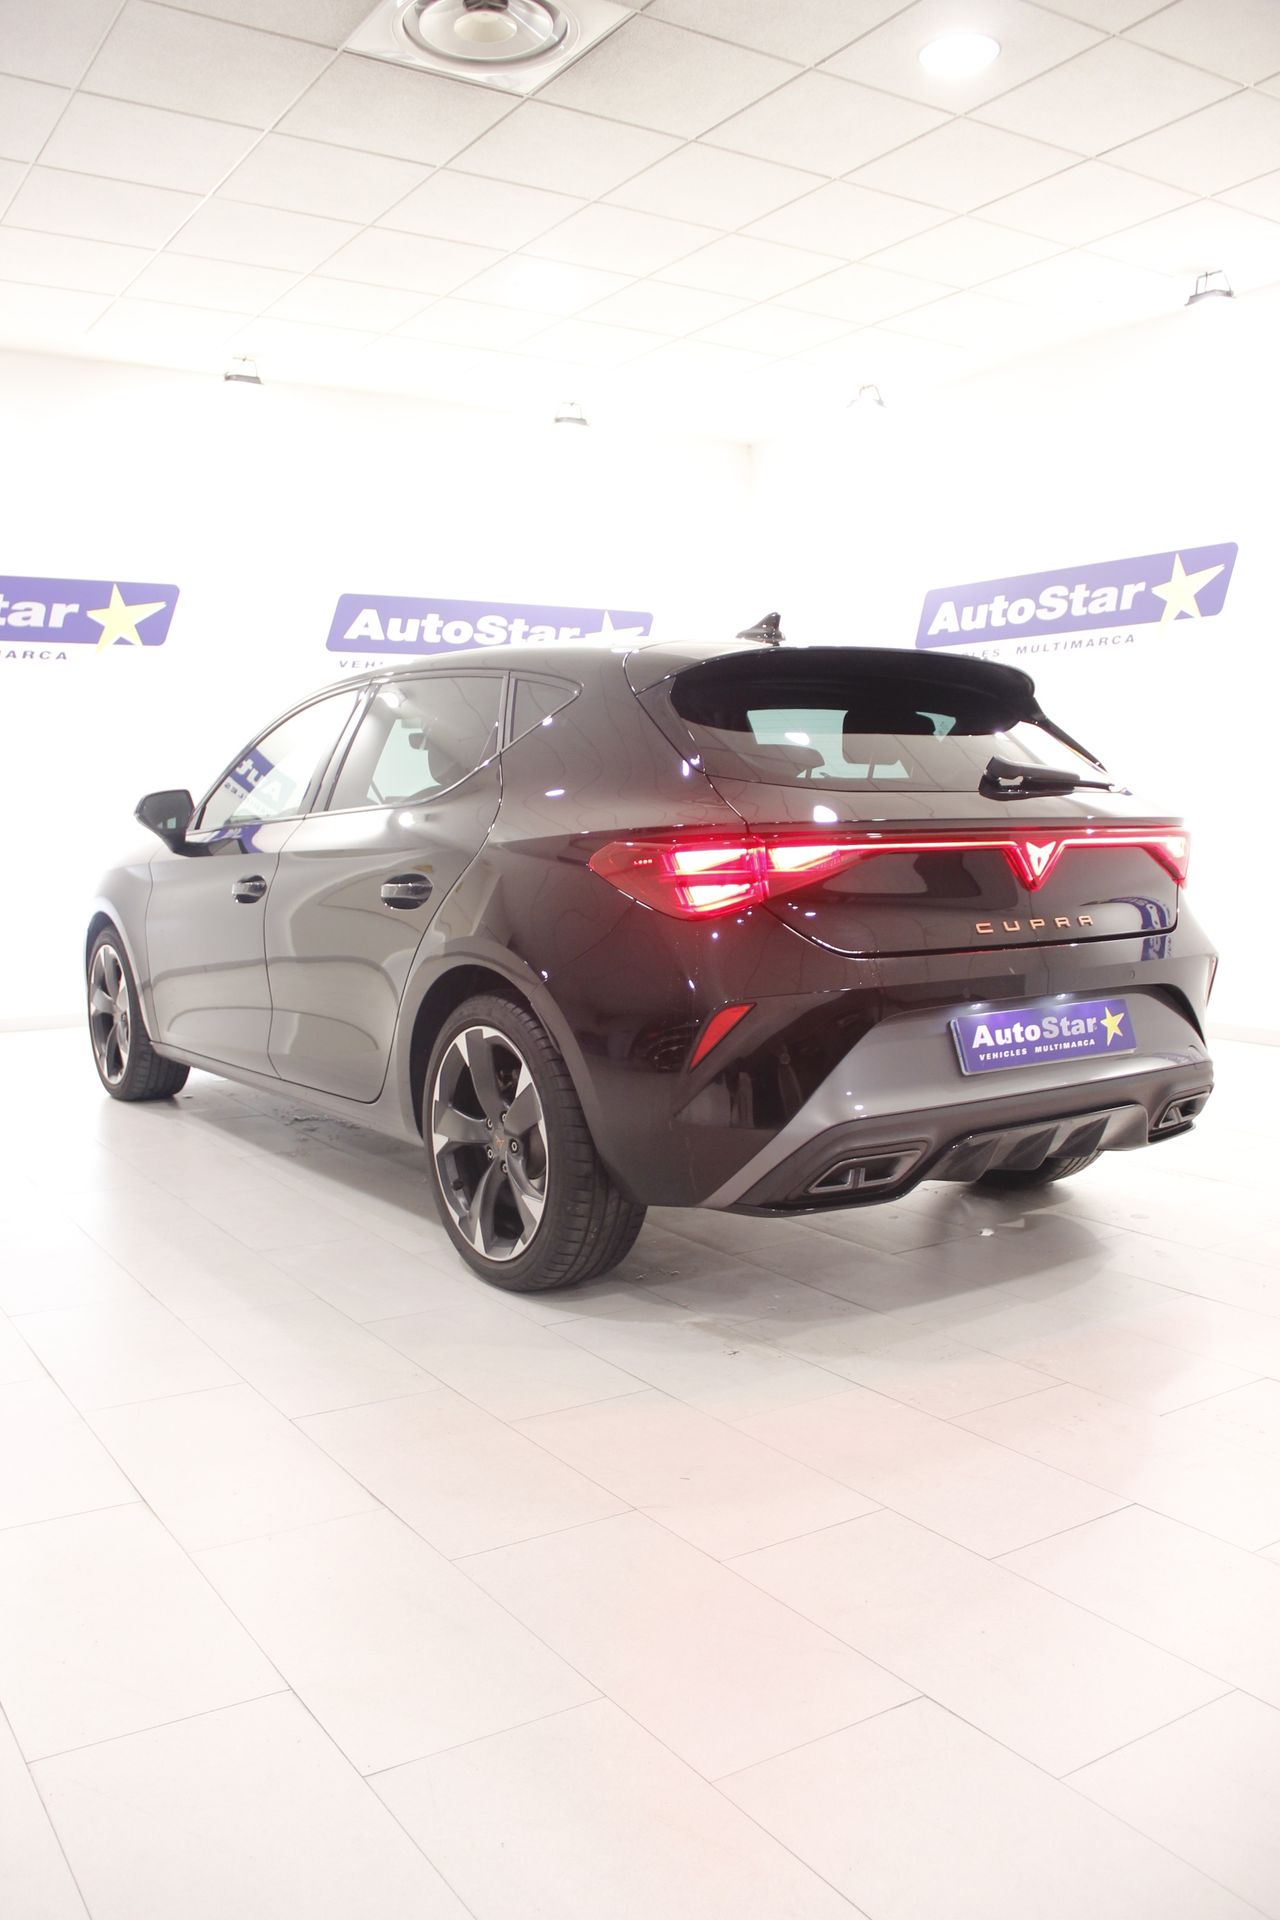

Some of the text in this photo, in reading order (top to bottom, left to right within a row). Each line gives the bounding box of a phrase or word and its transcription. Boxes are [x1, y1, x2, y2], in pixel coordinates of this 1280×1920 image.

[926, 580, 1147, 636] AutoStar
[0, 649, 68, 661] ARCA
[1015, 633, 1135, 655] MULTIMARCA
[975, 914, 1095, 935] CUPRA
[971, 1015, 1099, 1049] AutoStar
[979, 1038, 1096, 1061] VEHICLES MULTIMARCA
